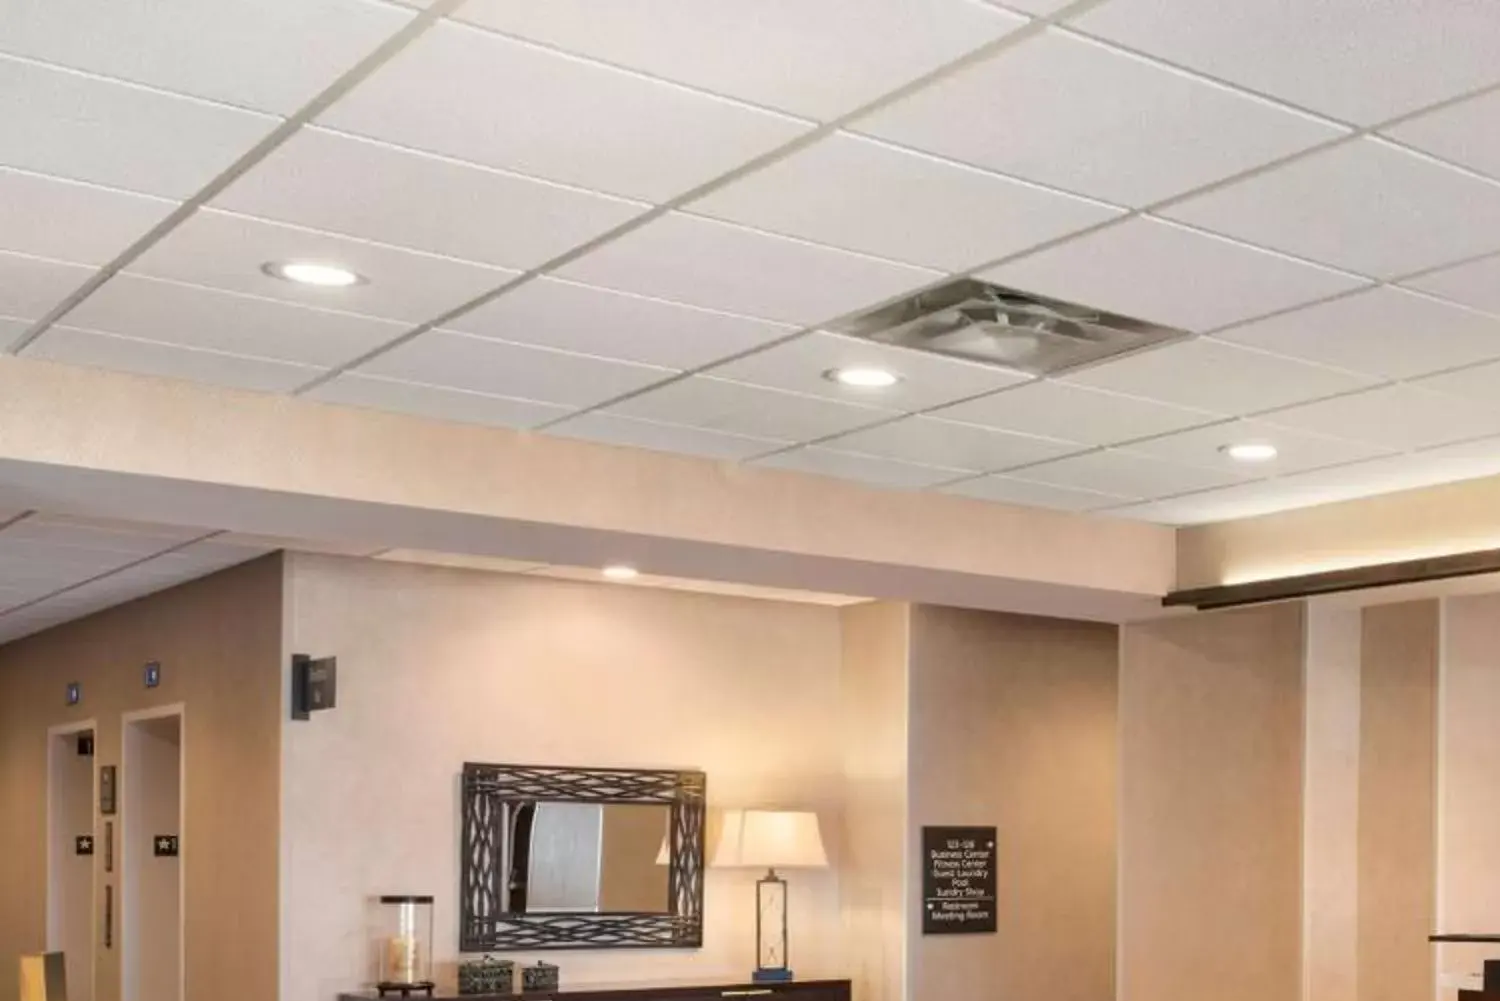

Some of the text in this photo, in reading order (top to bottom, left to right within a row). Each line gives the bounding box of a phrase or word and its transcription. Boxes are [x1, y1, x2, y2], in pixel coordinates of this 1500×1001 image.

[964, 850, 989, 858] Center
[934, 859, 986, 868] Fitness Center
[957, 869, 988, 879] Laundry
[932, 911, 988, 921] Meeting Room
